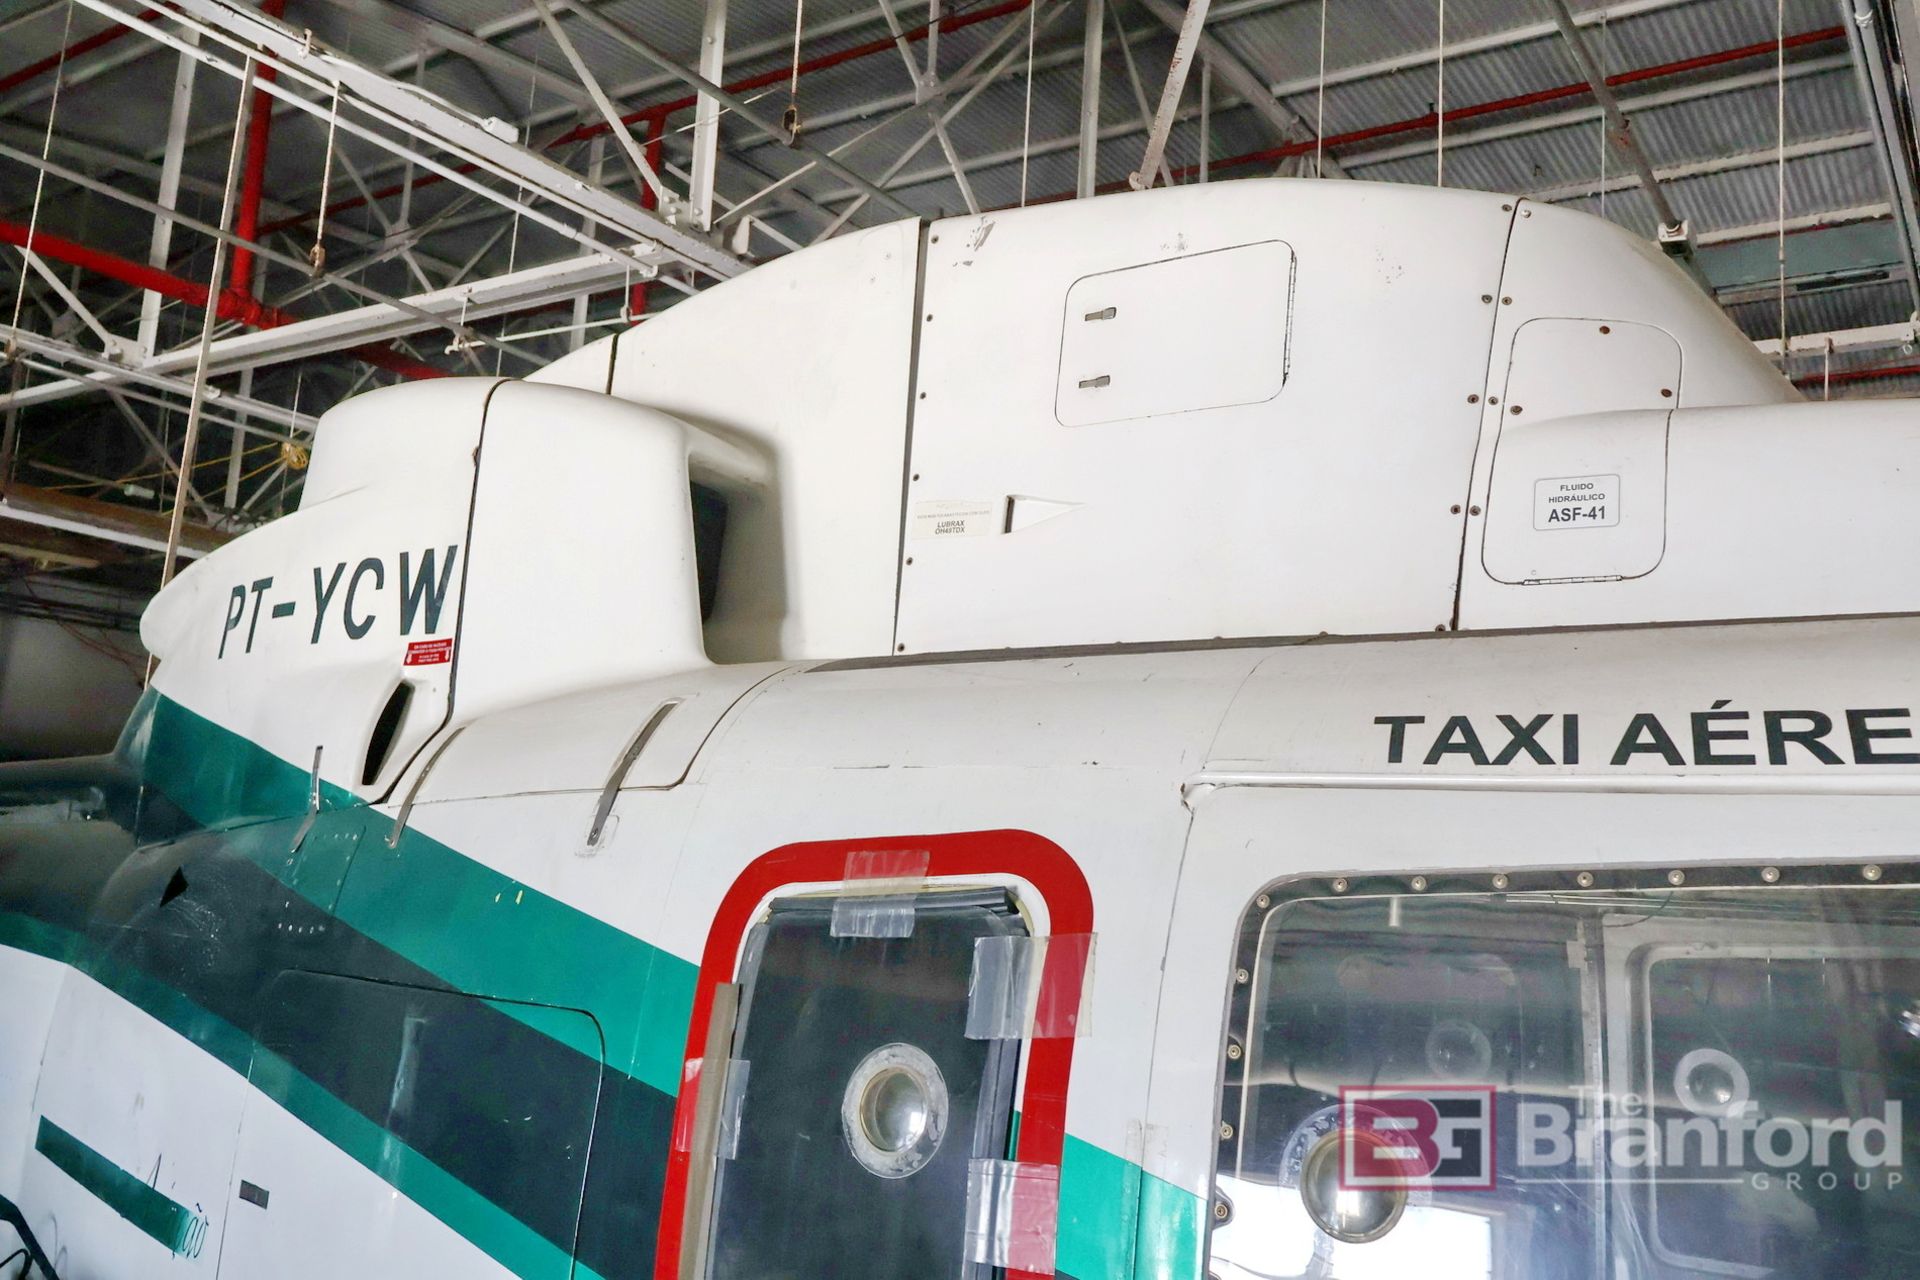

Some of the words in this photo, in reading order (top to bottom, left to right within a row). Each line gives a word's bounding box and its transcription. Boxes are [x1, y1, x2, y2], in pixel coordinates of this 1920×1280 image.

[1560, 483, 1594, 492] FLUIDO
[1548, 493, 1606, 503] HIDRÁULICO
[1548, 505, 1606, 523] ASF-41
[937, 520, 965, 528] LUBRAX
[218, 545, 458, 660] PT-YCW
[1374, 713, 1579, 765] TAXI
[1609, 700, 1920, 766] AÉRE
